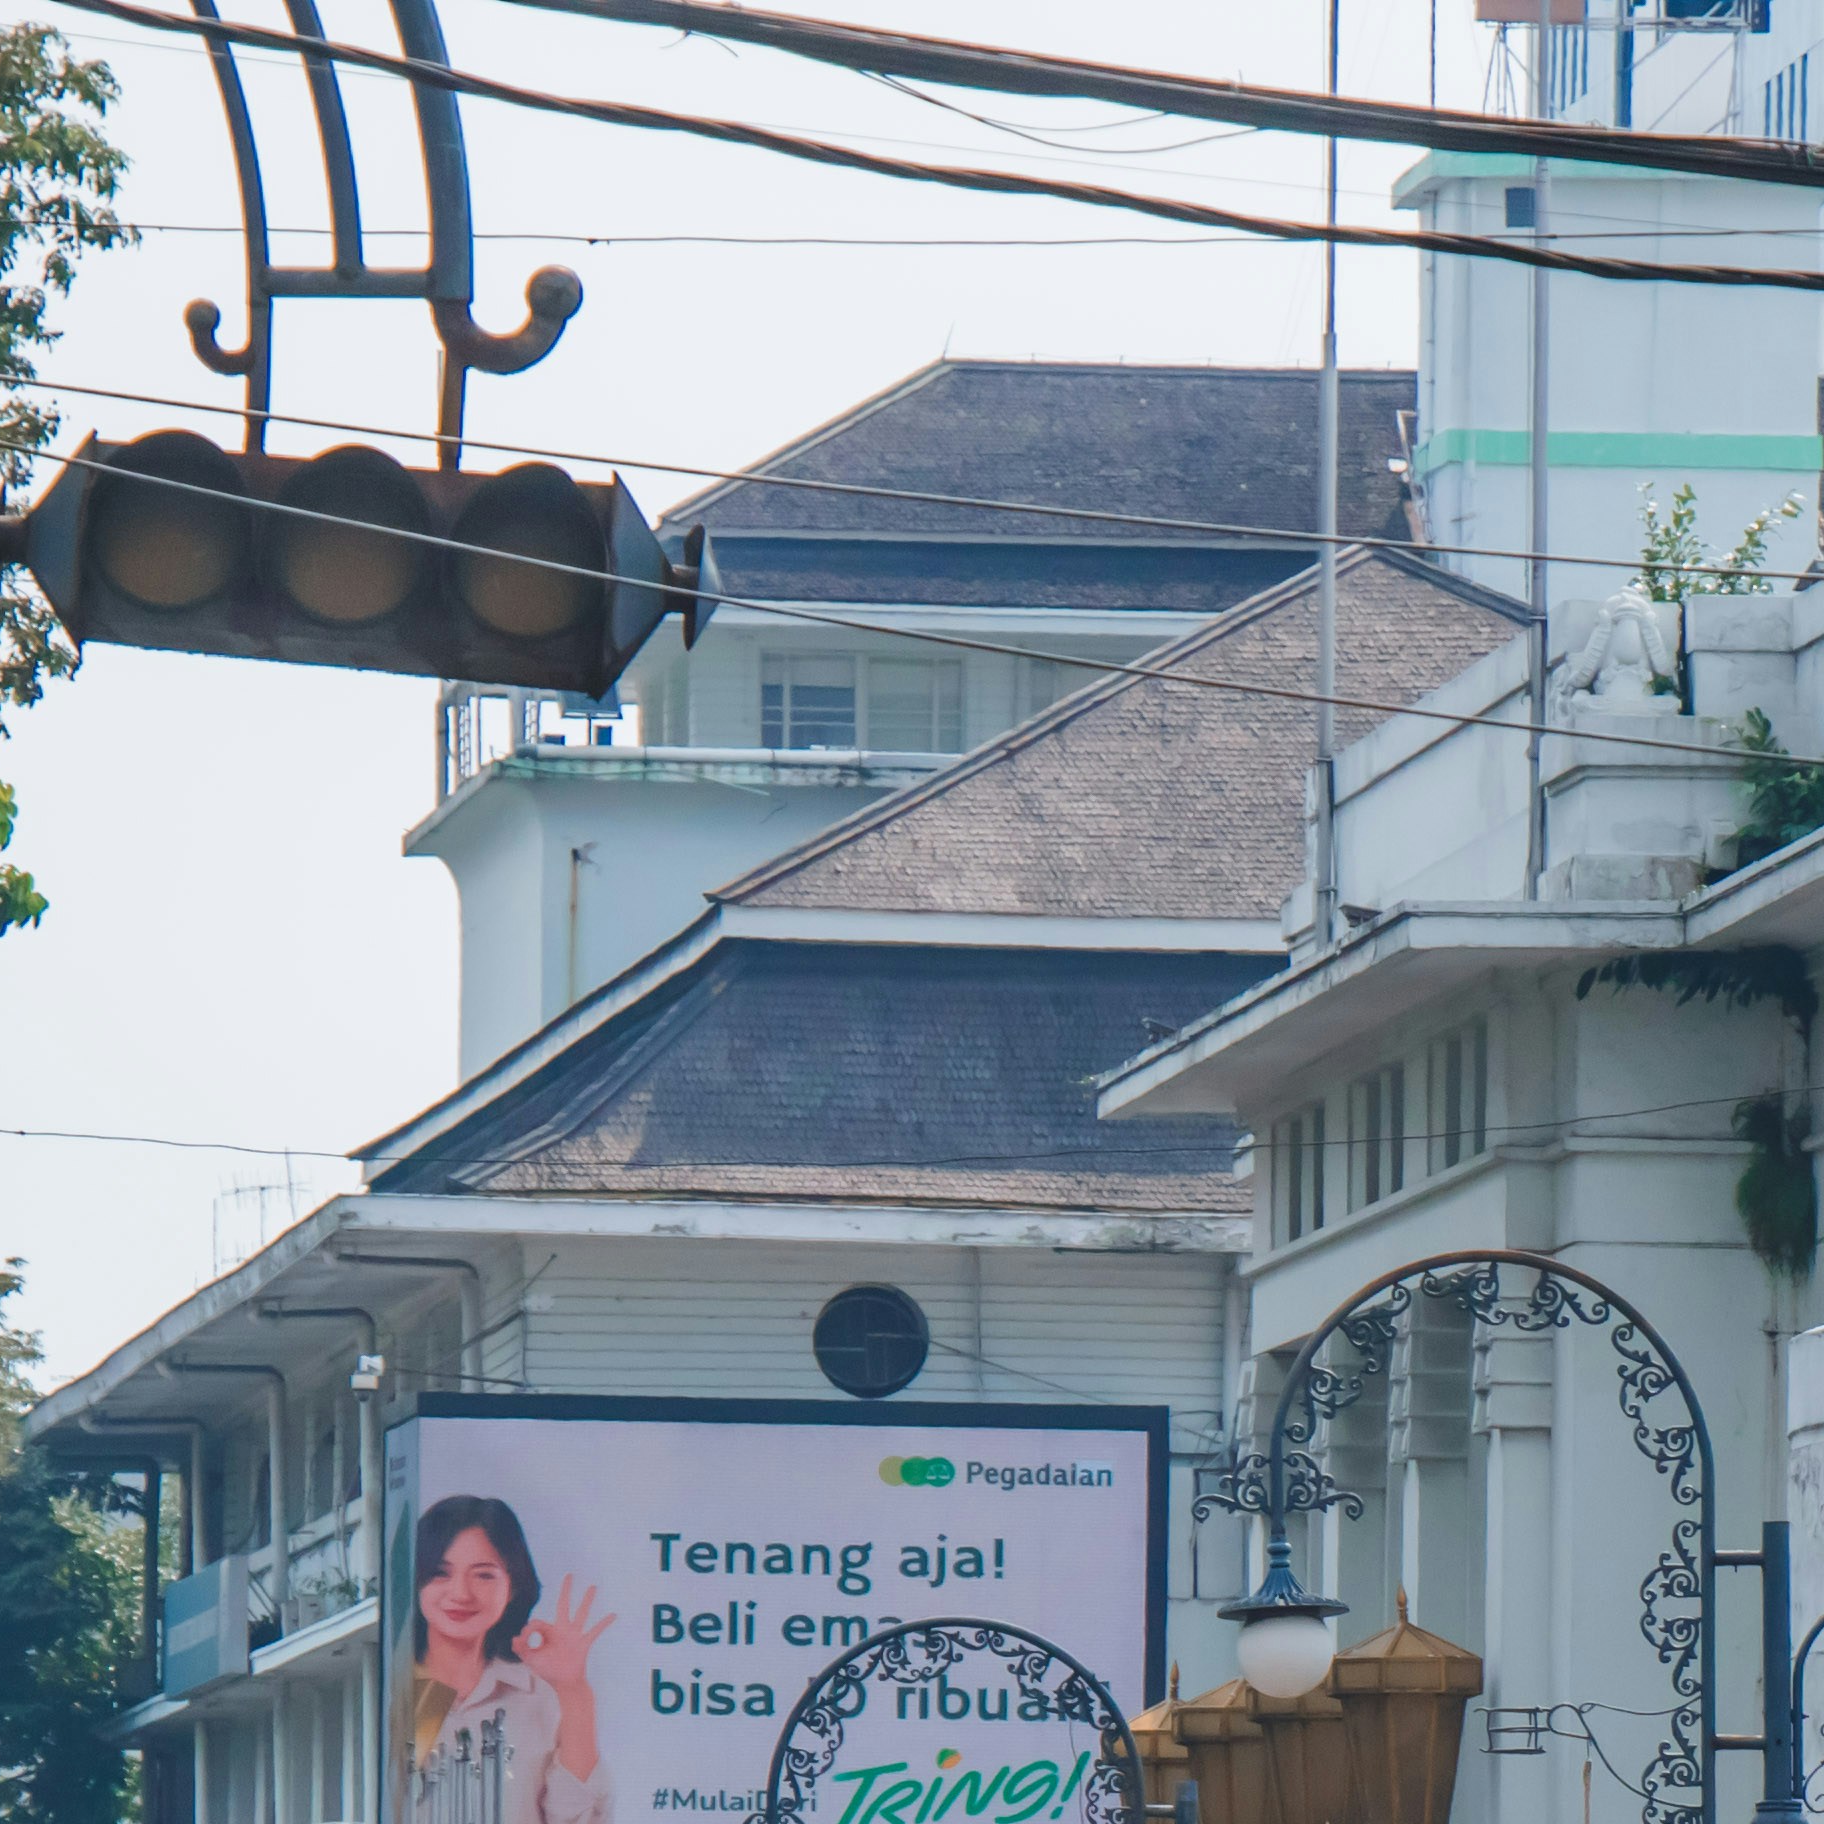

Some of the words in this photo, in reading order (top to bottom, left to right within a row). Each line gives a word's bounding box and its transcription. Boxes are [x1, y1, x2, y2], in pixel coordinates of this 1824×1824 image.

[966, 1461, 1113, 1491] Pegadaian
[650, 1532, 873, 1596] Tenang
[899, 1533, 1005, 1588] aja!
[651, 1600, 757, 1646] Beli
[650, 1669, 776, 1717] bisa
